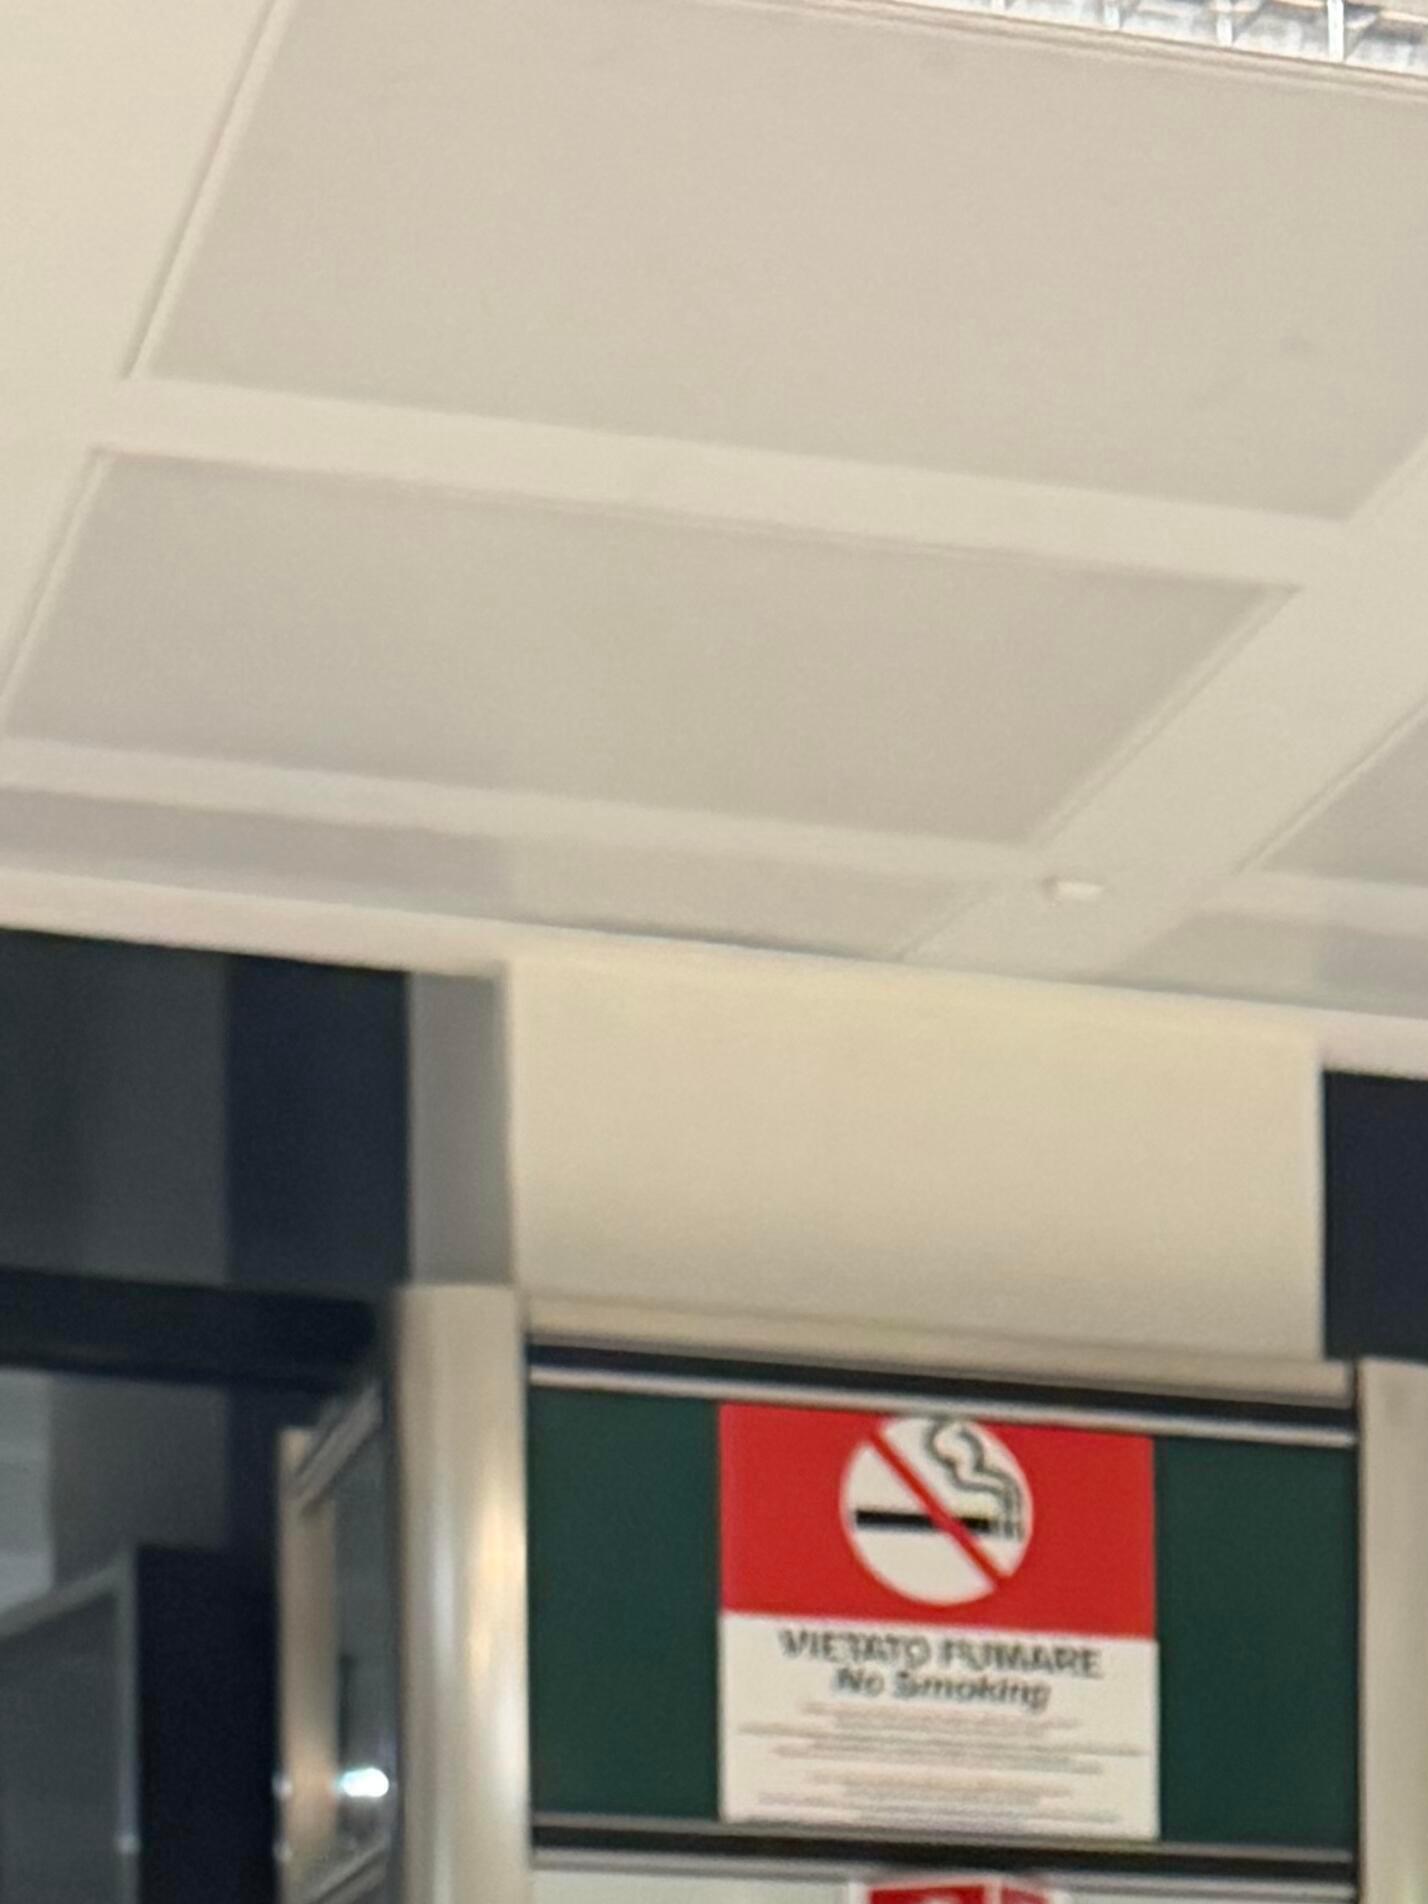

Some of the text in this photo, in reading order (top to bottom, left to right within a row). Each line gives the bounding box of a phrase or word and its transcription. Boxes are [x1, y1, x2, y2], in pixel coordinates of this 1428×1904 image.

[780, 1630, 1102, 1679] VIETATO FUMARE
[835, 1667, 1052, 1712] No Smoking
